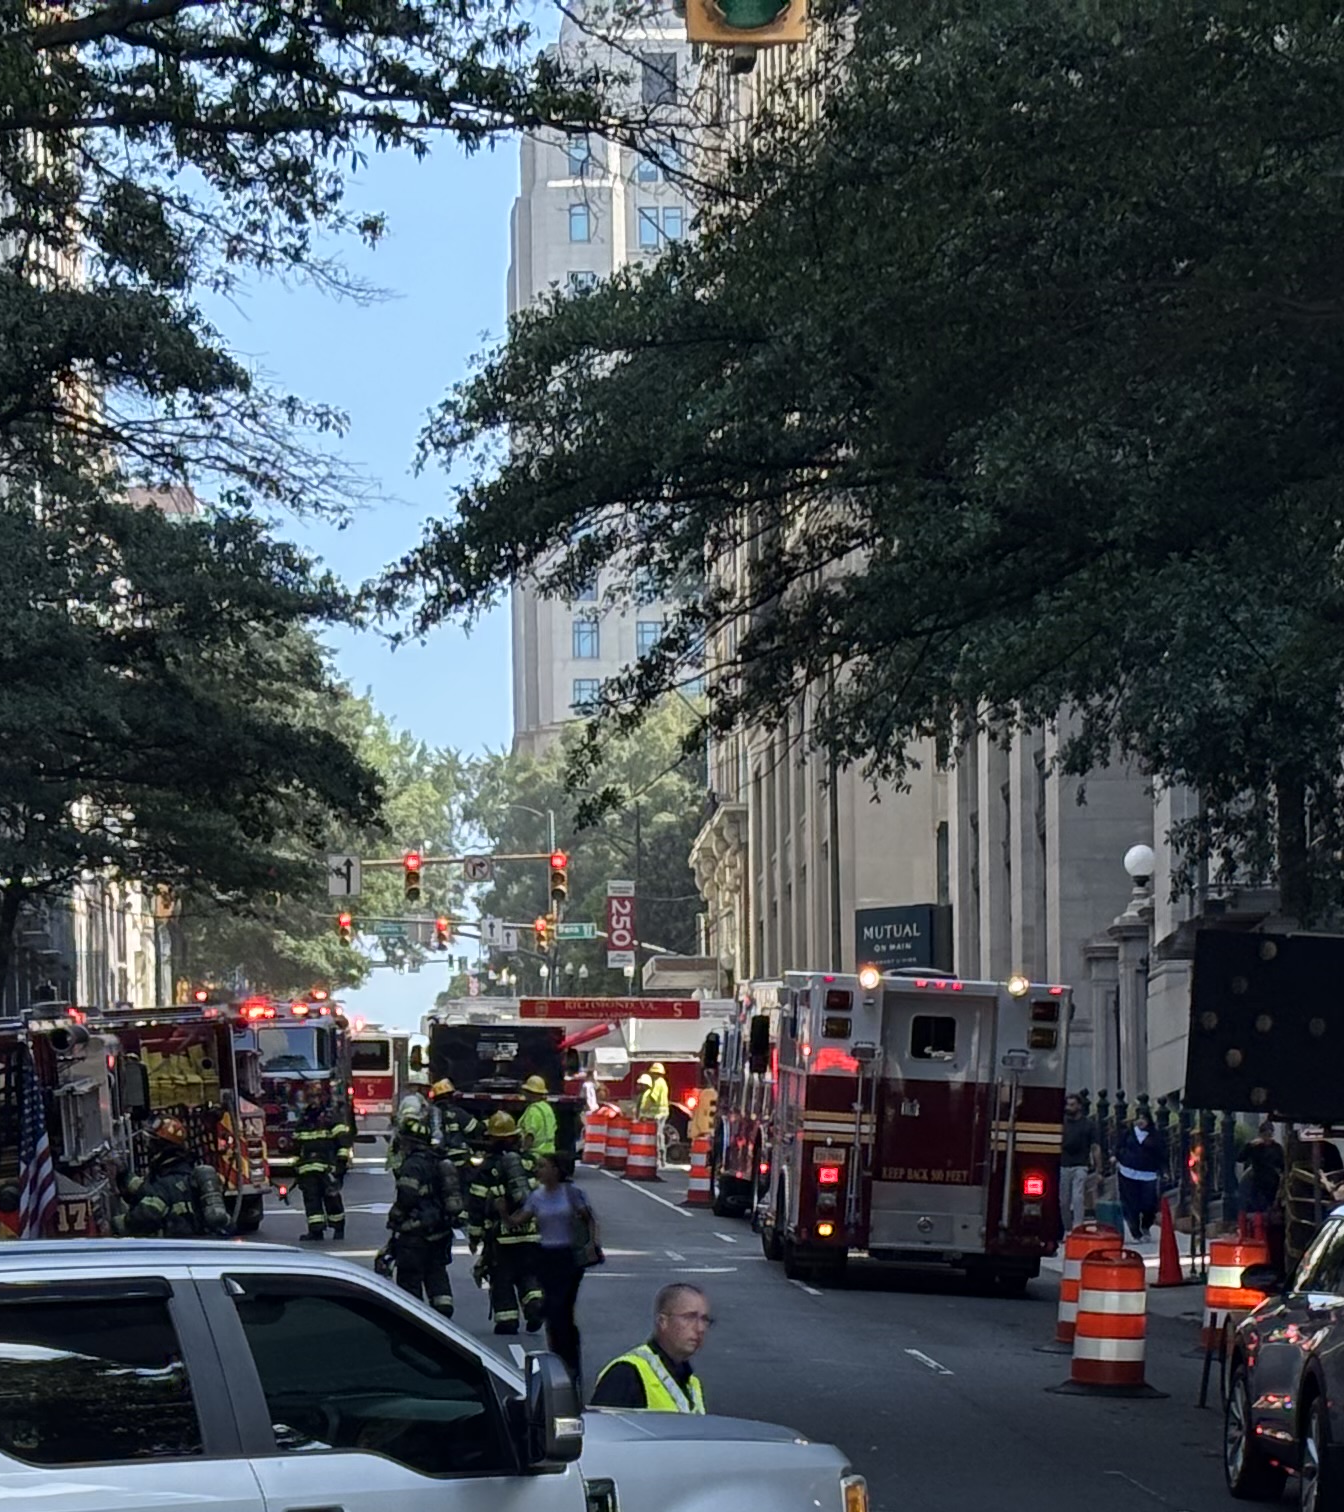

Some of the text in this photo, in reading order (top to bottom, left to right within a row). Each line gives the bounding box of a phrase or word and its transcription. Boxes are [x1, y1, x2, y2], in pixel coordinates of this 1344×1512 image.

[611, 900, 631, 946] 250
[863, 922, 921, 940] MUTUAL
[874, 942, 912, 953] ON MAIN
[882, 1167, 905, 1179] KEEP
[907, 1168, 928, 1180] BACK
[946, 1170, 968, 1182] FEET
[57, 1202, 87, 1231] 17
